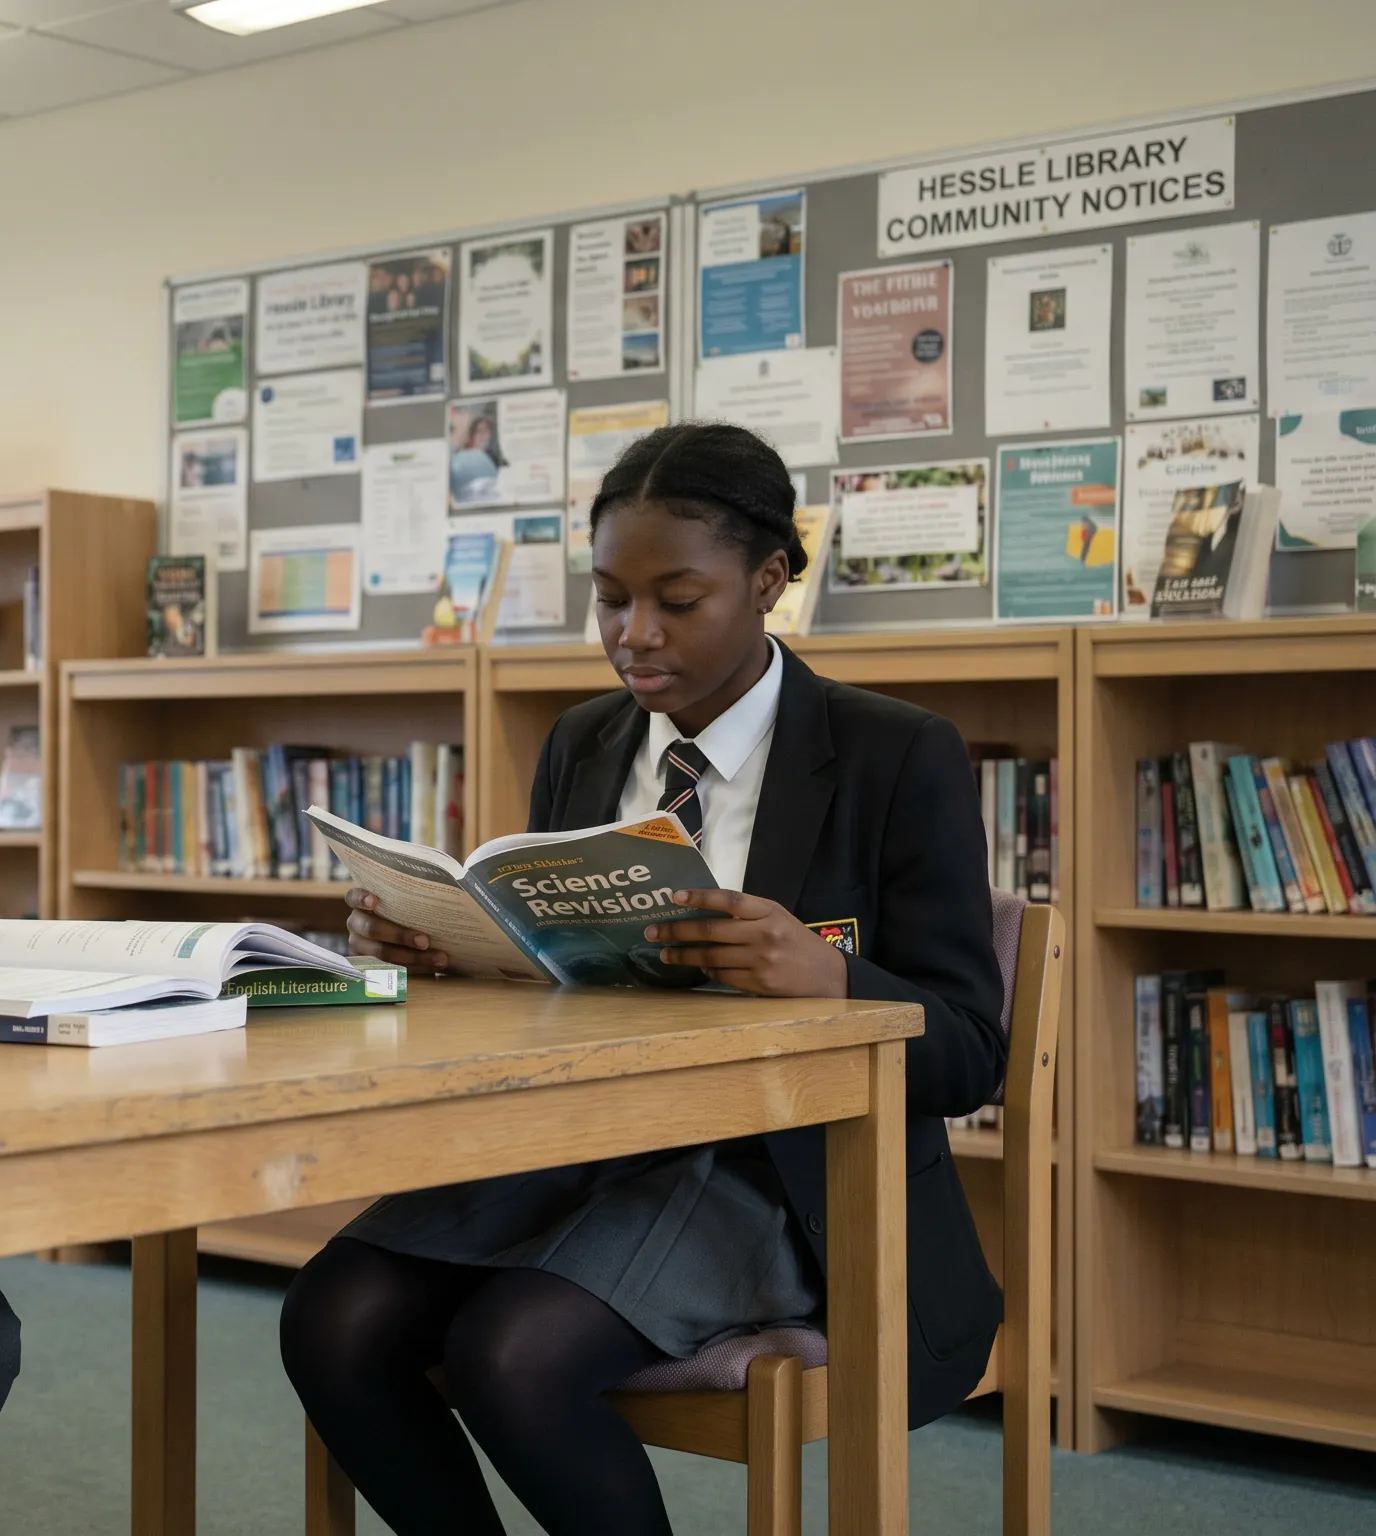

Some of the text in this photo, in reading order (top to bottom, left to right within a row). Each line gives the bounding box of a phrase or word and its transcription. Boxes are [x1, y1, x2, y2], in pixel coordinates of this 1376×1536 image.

[918, 136, 1188, 202] HESSLE LIBRARY
[886, 170, 1226, 242] COMMUNITY NOTICES
[512, 864, 652, 898] Science
[526, 887, 675, 918] Revision
[227, 981, 348, 999] English Literature
